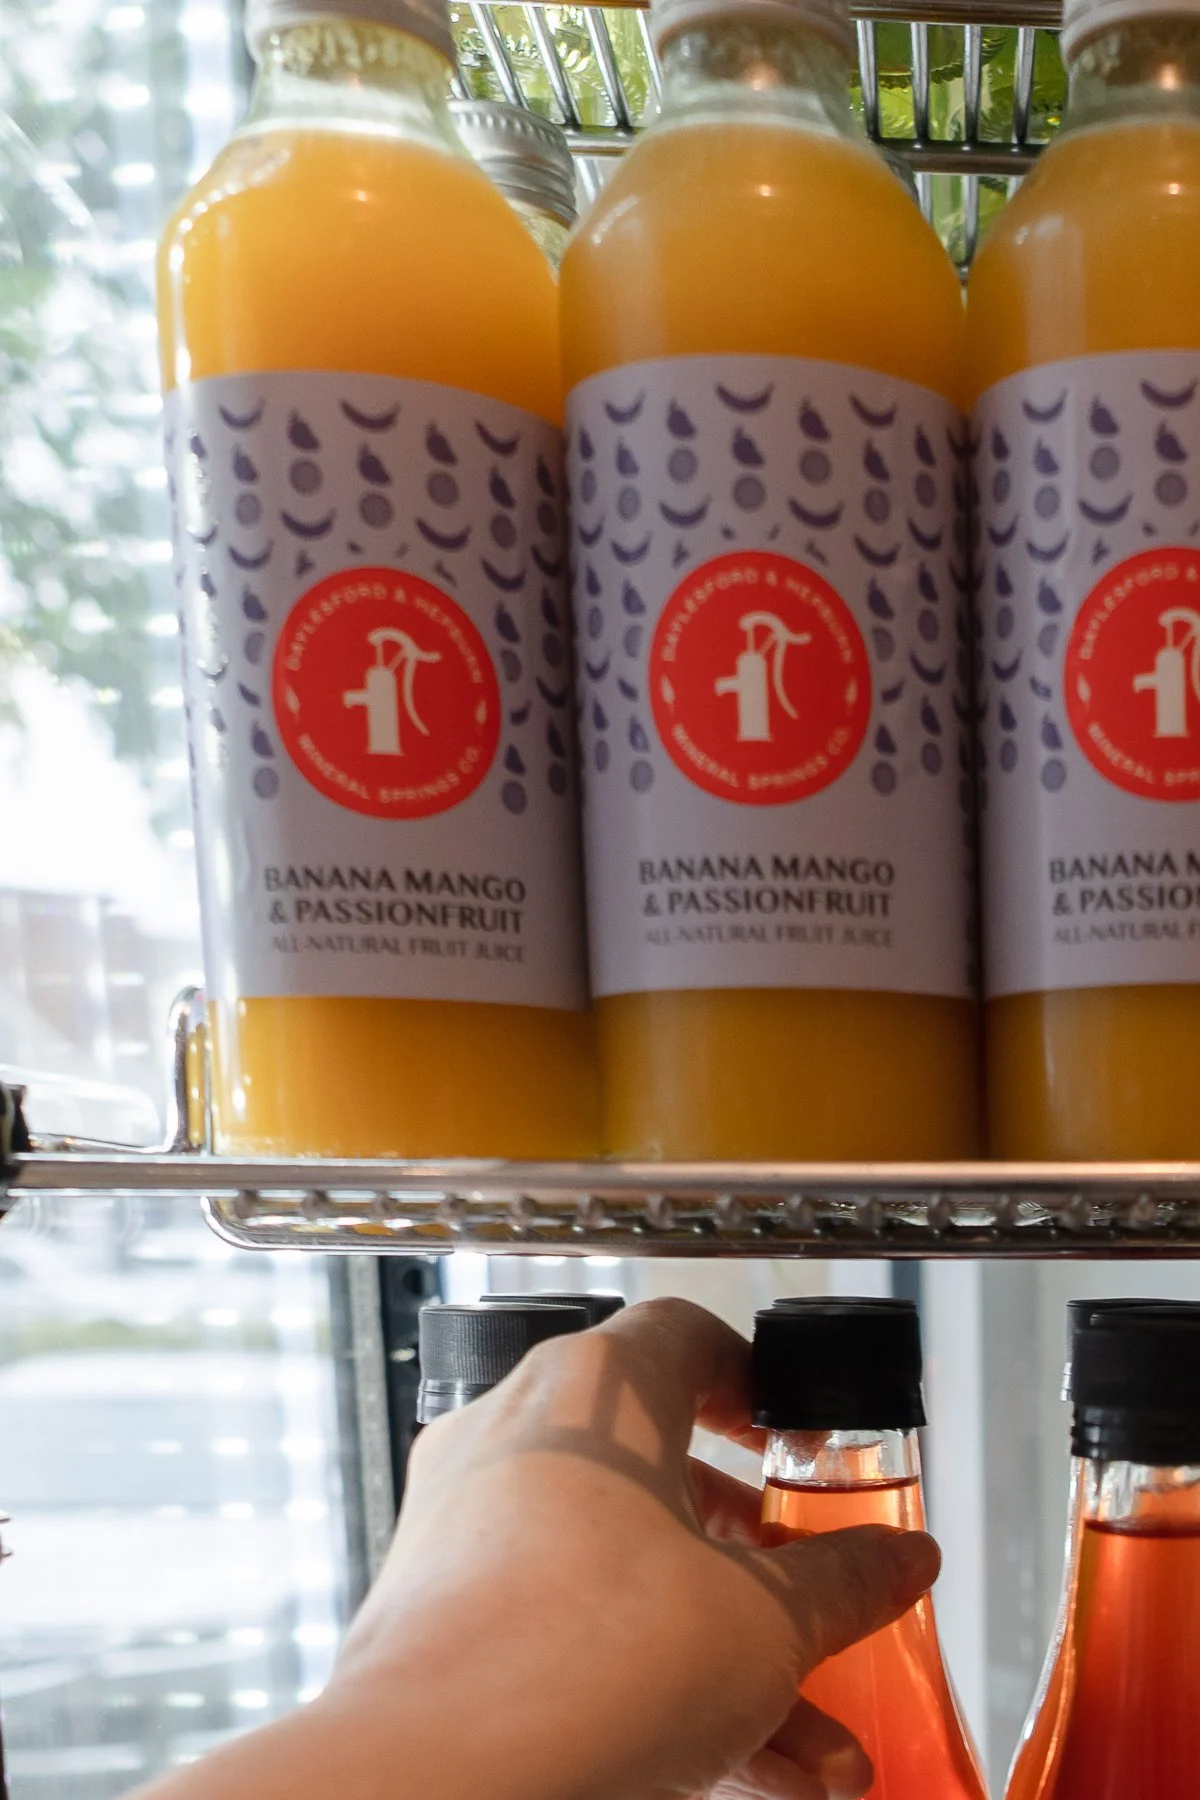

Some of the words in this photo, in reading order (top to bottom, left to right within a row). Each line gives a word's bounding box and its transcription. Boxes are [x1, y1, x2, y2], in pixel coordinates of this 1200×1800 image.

[264, 865, 396, 892] BANANA
[405, 868, 526, 903] MANGO
[639, 853, 763, 884] BANANA
[771, 854, 895, 887] MANGO
[1050, 851, 1177, 884] BANANA
[269, 900, 287, 924] &
[295, 900, 523, 934] PASSIONFRUIT
[643, 893, 661, 917] &
[669, 887, 890, 917] PASSIONFRUIT
[1053, 891, 1071, 916] &
